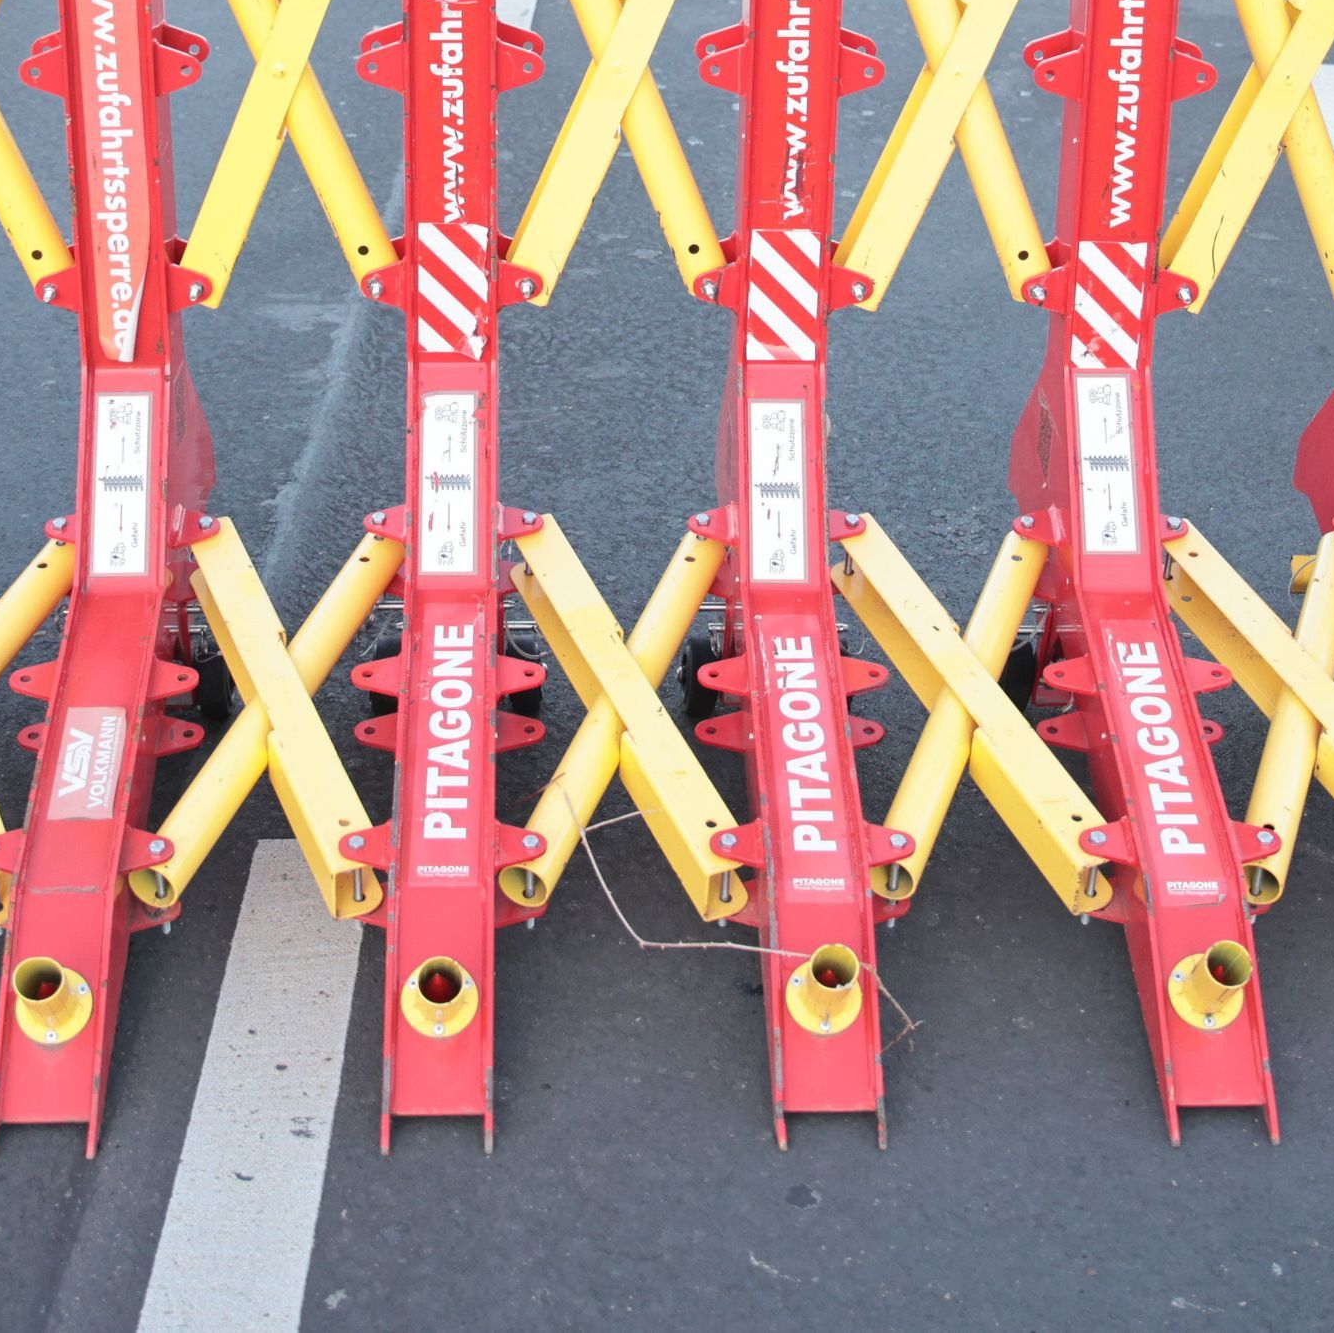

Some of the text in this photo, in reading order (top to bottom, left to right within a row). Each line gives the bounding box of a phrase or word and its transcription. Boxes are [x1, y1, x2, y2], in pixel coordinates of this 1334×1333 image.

[133, 411, 142, 454] Schutzzone
[1115, 392, 1124, 435] Schutzzone
[788, 418, 796, 462] Schutzzone
[131, 522, 139, 548] Gefahr
[1121, 501, 1130, 527] Gefahr
[789, 529, 797, 555] Gefahr
[423, 624, 474, 840] PITAGONE
[778, 635, 837, 852] PITAGONE
[1117, 641, 1205, 854] PITAGONE
[87, 715, 118, 809] VOLKMANN
[417, 865, 469, 873] PITAGONE
[792, 877, 845, 885] PITAGONE
[1166, 881, 1219, 890] PITAGONE
